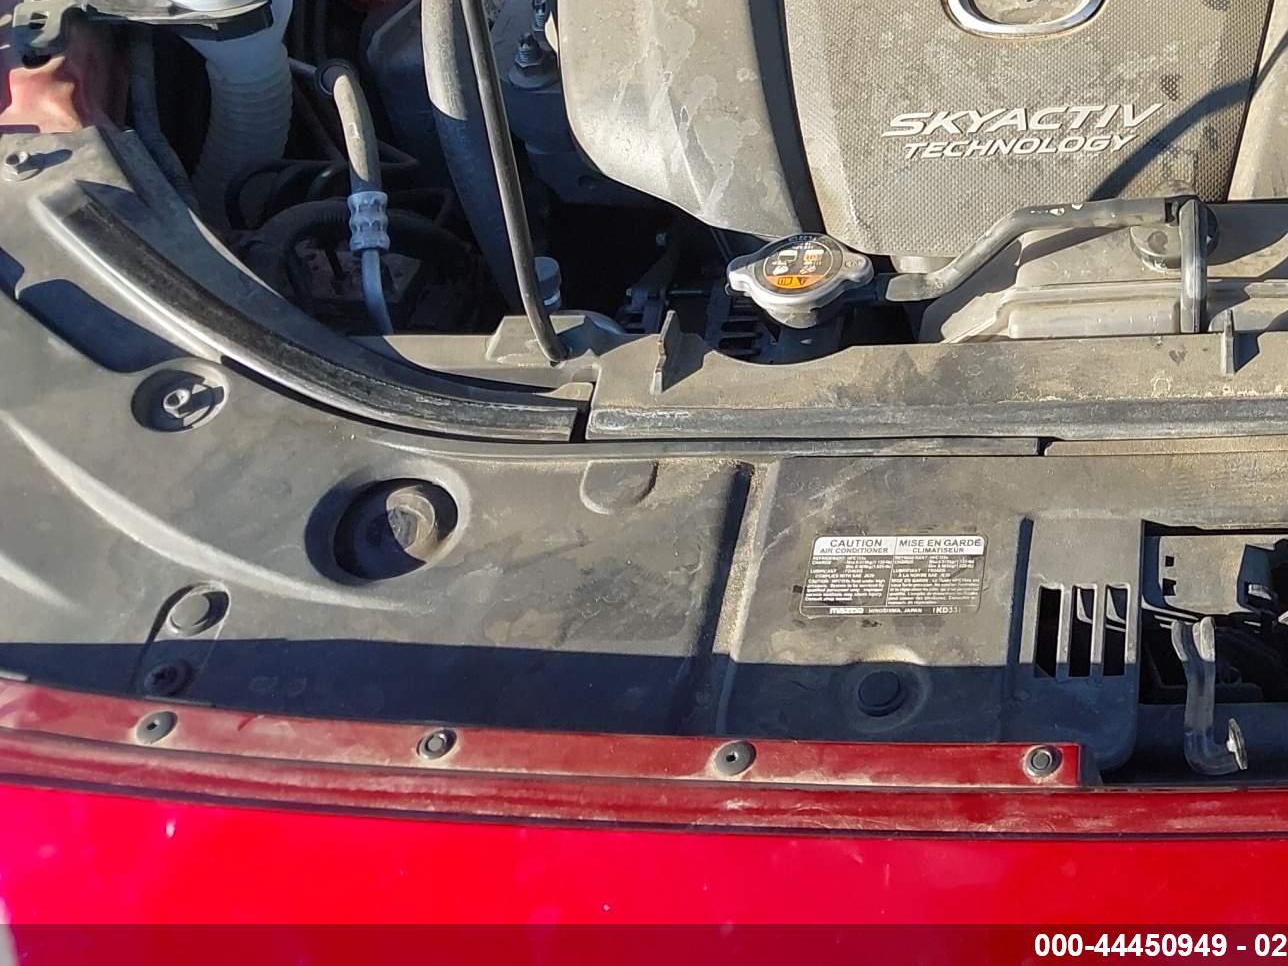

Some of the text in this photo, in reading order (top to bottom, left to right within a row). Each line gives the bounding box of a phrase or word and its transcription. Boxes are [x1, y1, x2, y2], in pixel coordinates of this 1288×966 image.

[881, 102, 1165, 138] SKYACTIV
[903, 134, 1140, 160] TECHNOLOGY
[830, 539, 883, 548] CAUTION
[898, 538, 982, 547] MISE EN GARDE
